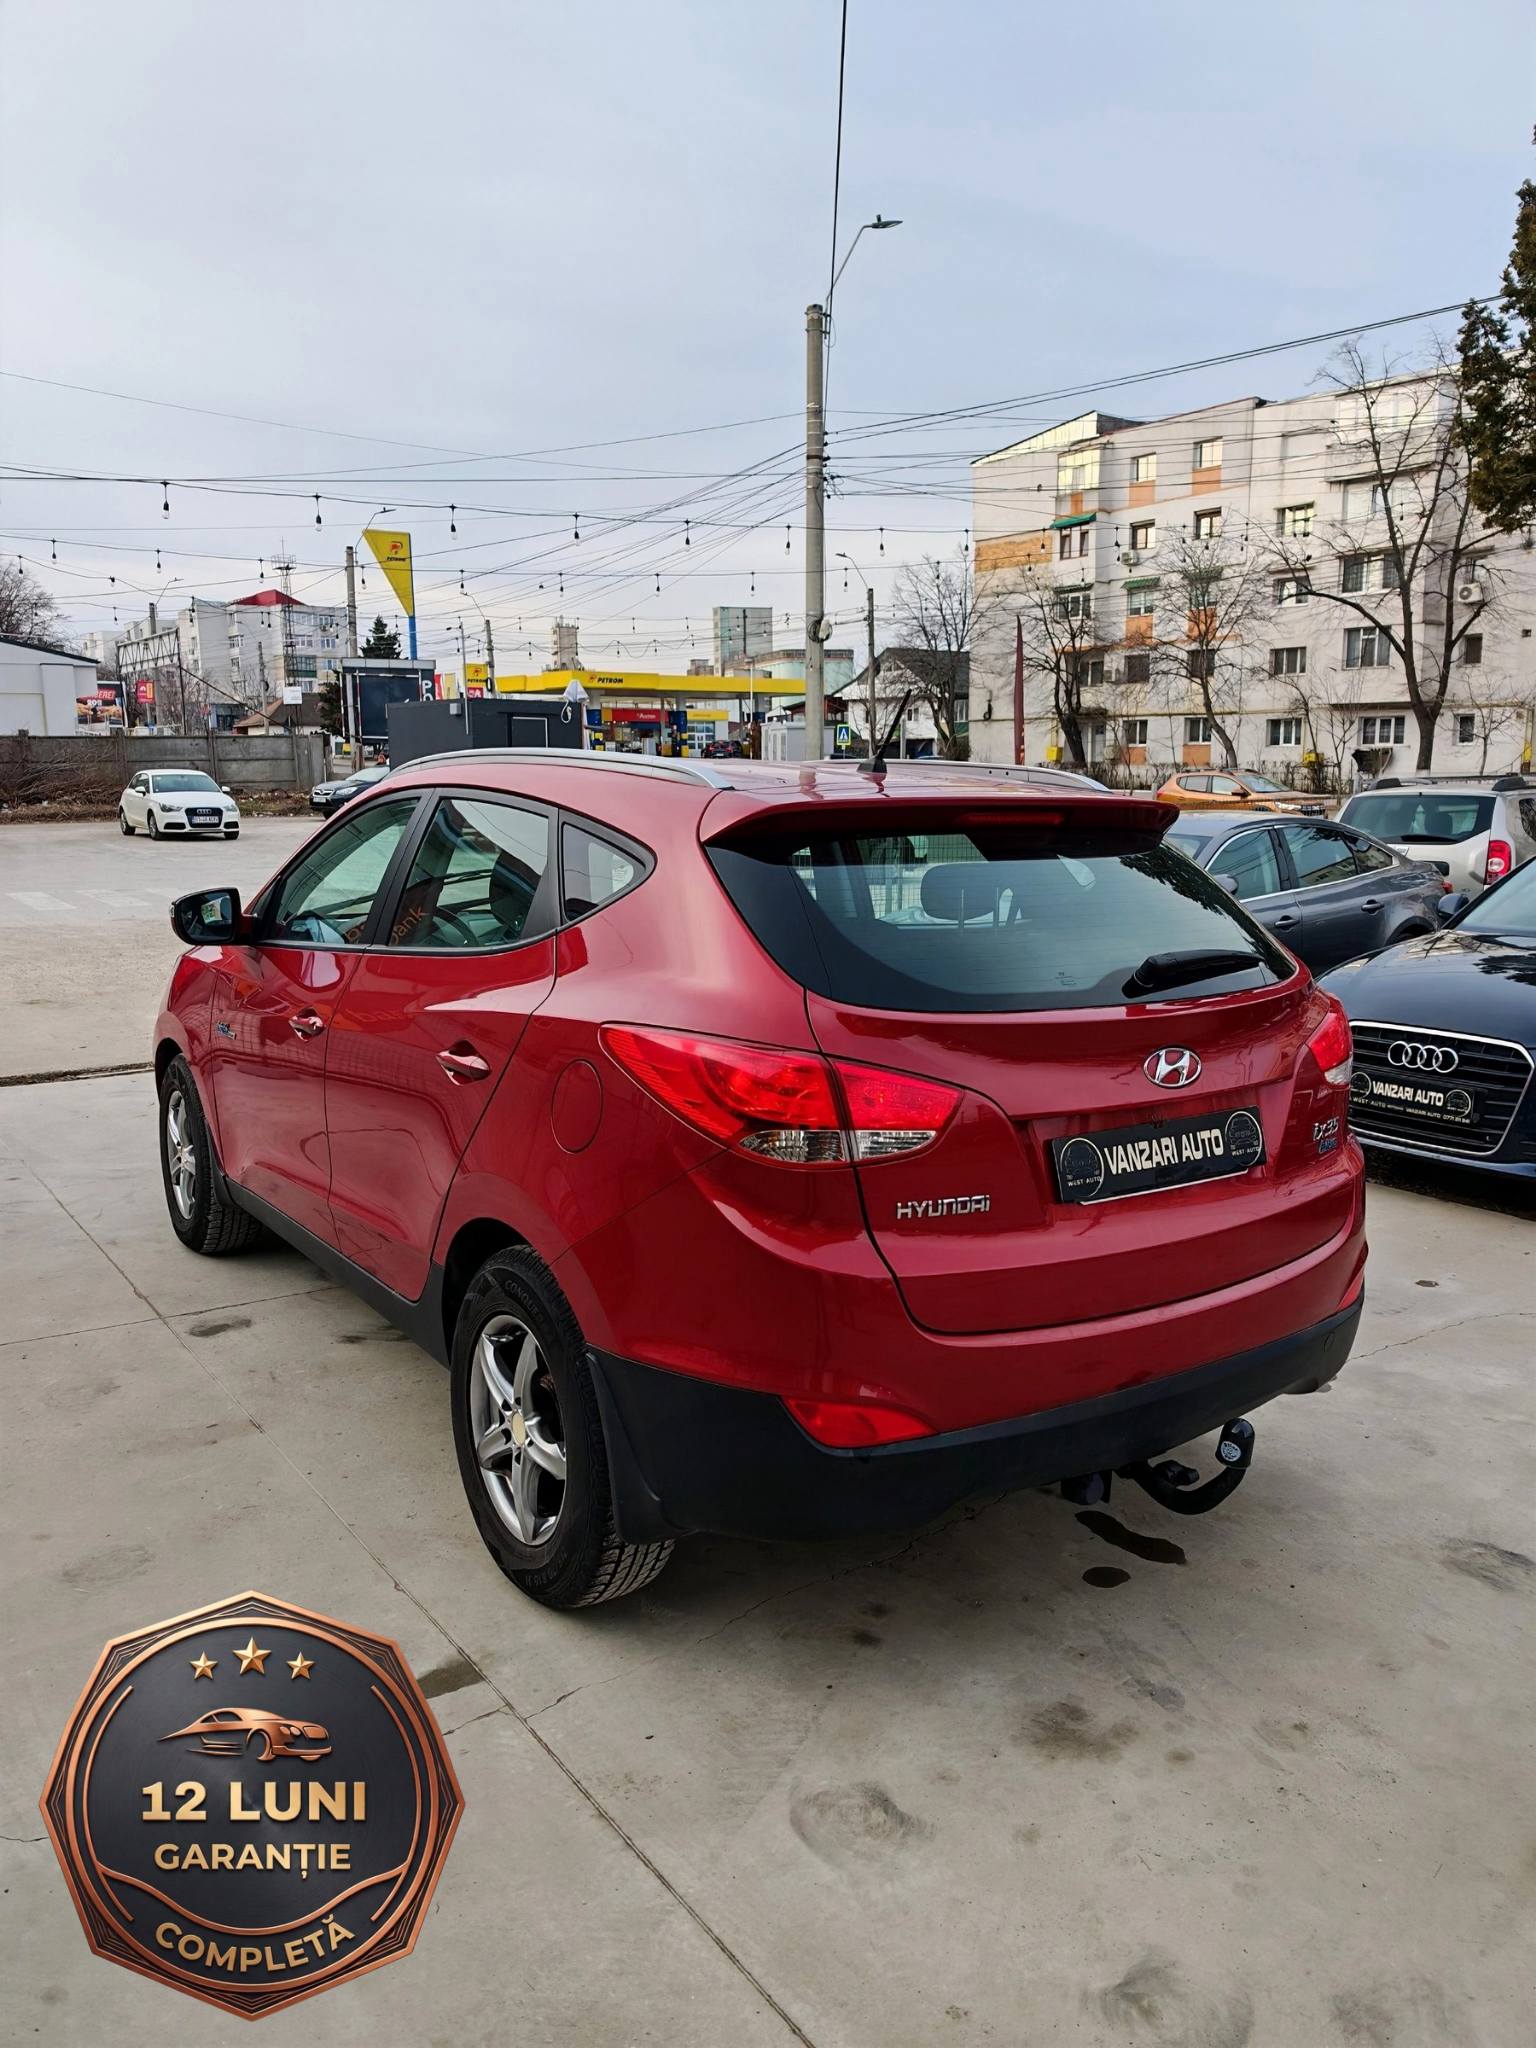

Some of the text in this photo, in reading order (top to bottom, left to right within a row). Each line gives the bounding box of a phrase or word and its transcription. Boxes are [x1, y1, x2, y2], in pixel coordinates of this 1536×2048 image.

[1372, 1081, 1444, 1107] VANZARI AUTO
[1312, 1116, 1339, 1141] ix35
[1104, 1128, 1224, 1175] VANZARI AUTO
[1068, 1176, 1101, 1187] WEST AUTO
[896, 1195, 990, 1220] HYUNDAI
